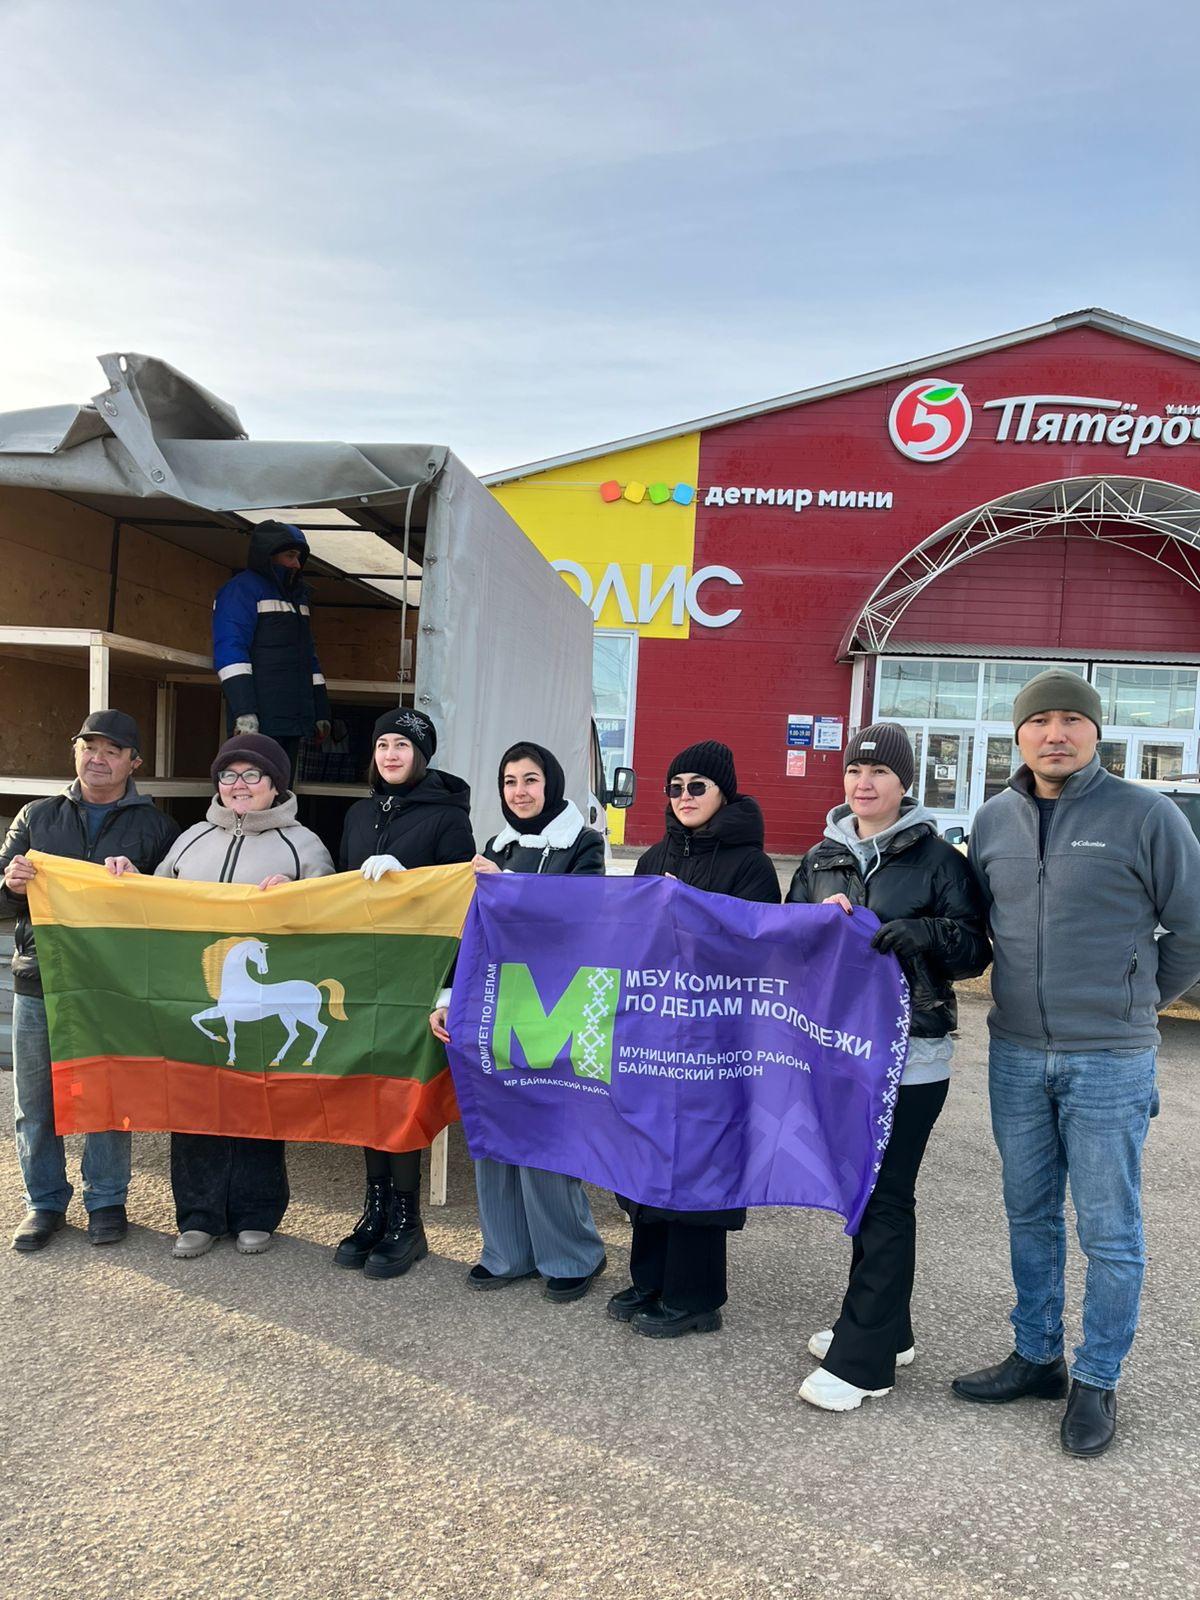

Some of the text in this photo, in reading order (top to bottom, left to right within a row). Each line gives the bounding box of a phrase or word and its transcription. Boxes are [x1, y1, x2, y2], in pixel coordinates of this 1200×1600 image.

[904, 402, 952, 456] 5
[705, 486, 894, 512] детмир мини
[625, 969, 789, 996] МБУ КОМИТЕТ
[478, 963, 497, 1074] КОМИТЕТ ПО ДЕЛАМ
[625, 994, 872, 1060] ПО ДЕЛАМ МОЛОДЕЖИ
[618, 1061, 763, 1081] БАЙМАКСКИЙ РАЙОН
[619, 1046, 811, 1073] МУНИЦИПАЛЬНОГО РАЙОНА
[504, 1079, 517, 1087] МР
[520, 1077, 581, 1090] БАЙМАКСКИЙ
